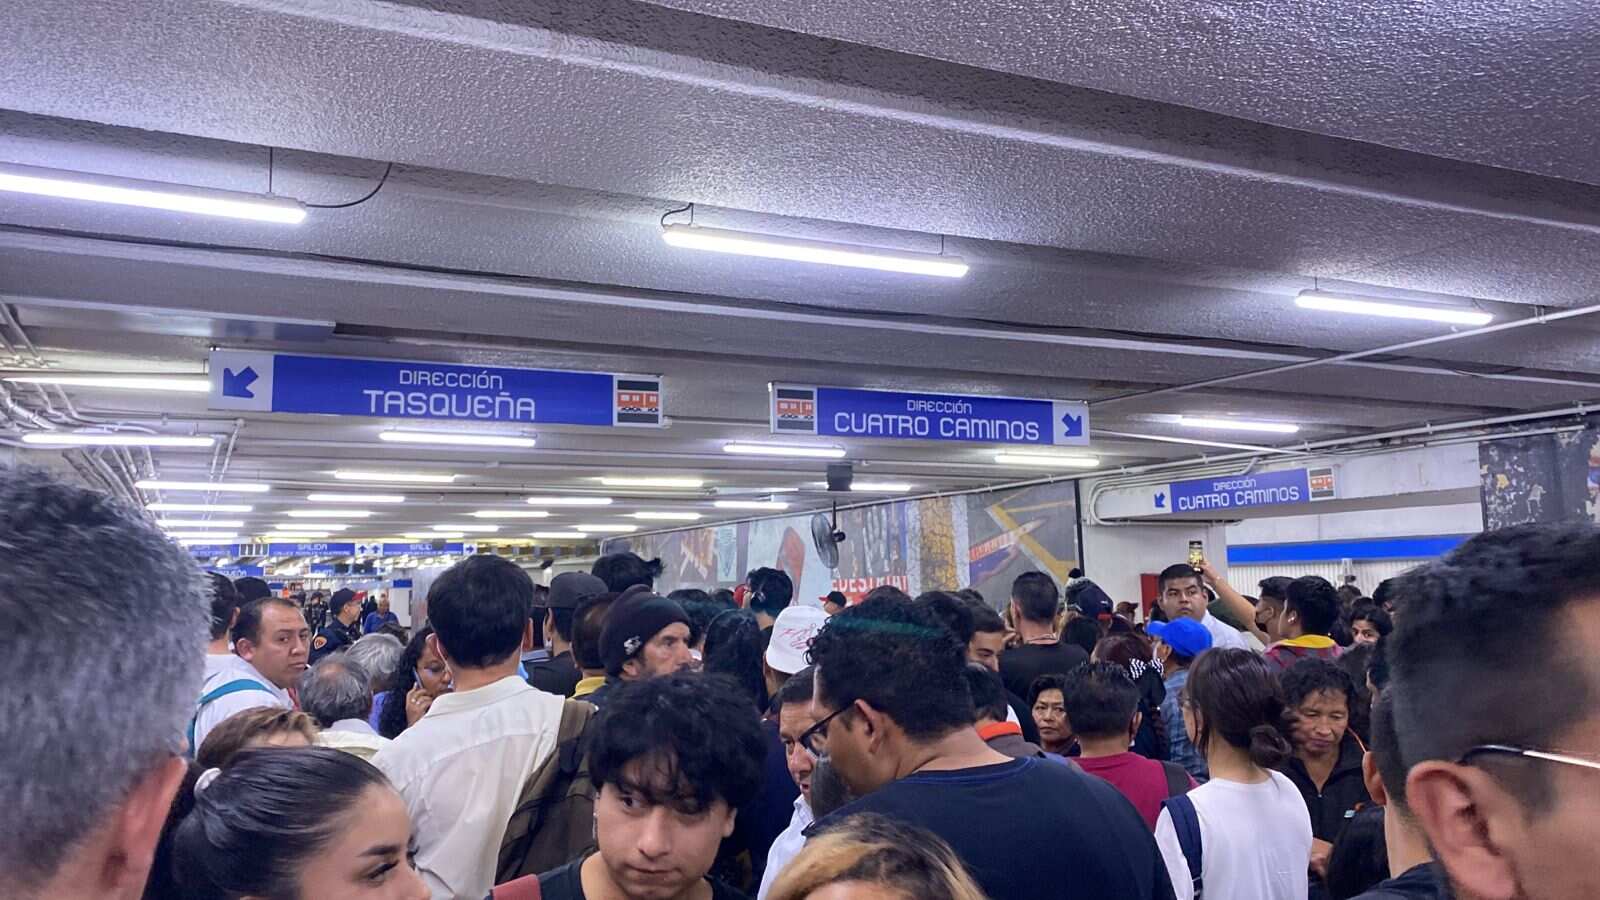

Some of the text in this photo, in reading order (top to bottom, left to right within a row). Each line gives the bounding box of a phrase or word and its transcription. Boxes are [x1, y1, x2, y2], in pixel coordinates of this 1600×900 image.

[399, 369, 504, 391] DIRECCIÓN
[362, 388, 537, 420] TASQUEÑA
[906, 399, 973, 415] DIRECCIÓN
[834, 412, 1040, 441] CUATRO CAMINOS
[1213, 476, 1257, 492] DIRECCIÓN
[1178, 486, 1300, 511] CUATRO CAMINOS
